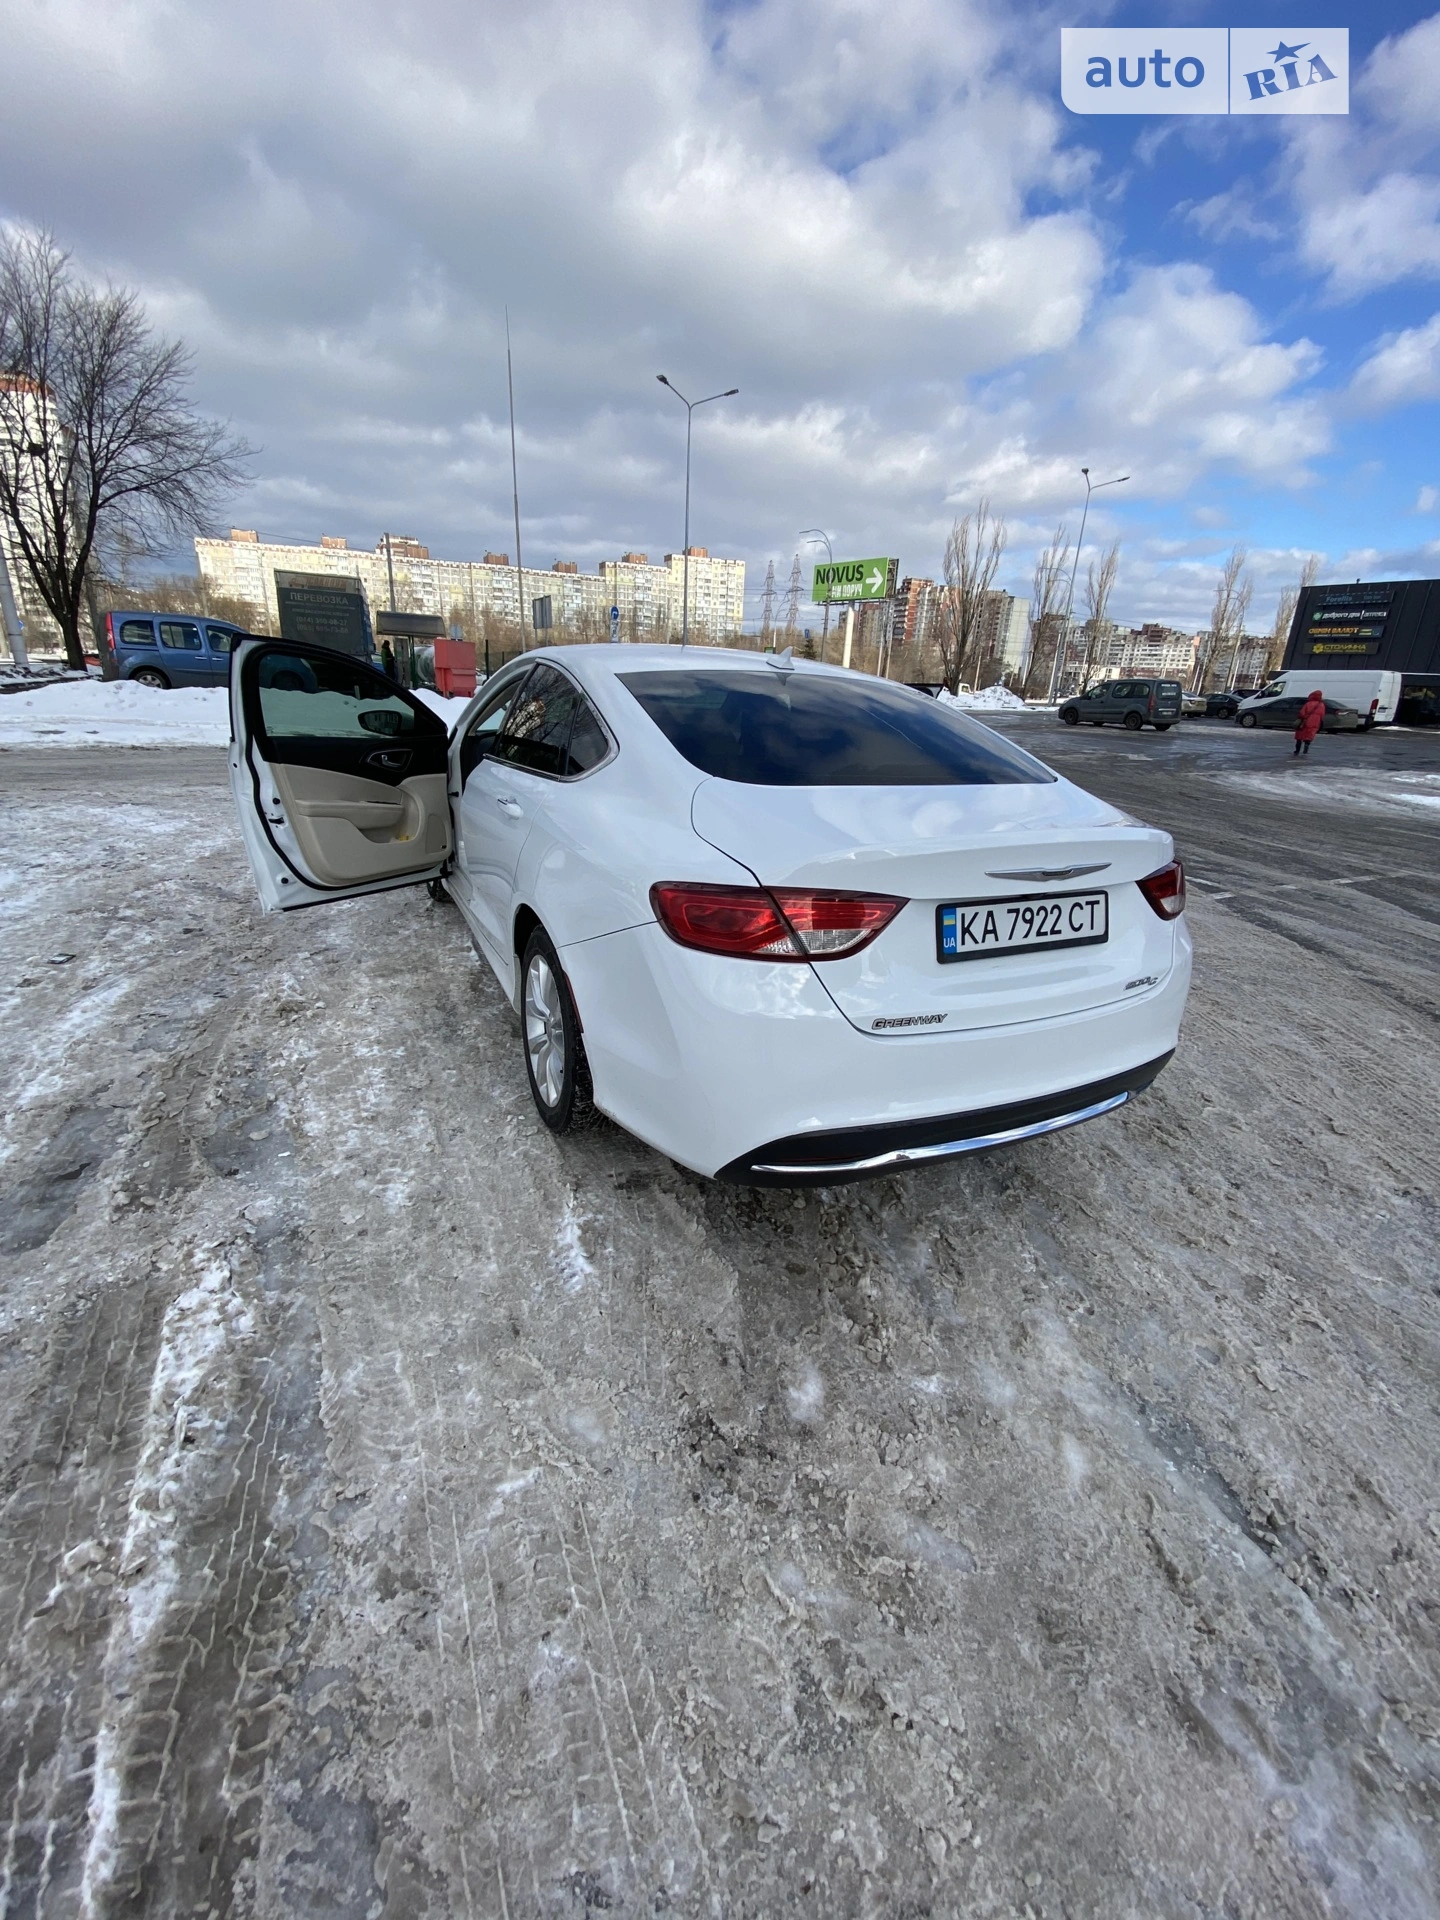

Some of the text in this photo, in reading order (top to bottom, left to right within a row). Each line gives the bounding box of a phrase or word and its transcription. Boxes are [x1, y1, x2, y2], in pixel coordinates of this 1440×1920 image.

[815, 563, 864, 585] NOVUS
[290, 592, 349, 605] ПЕРЕВОЗКА
[943, 900, 1100, 948] UA KA 7922 CT
